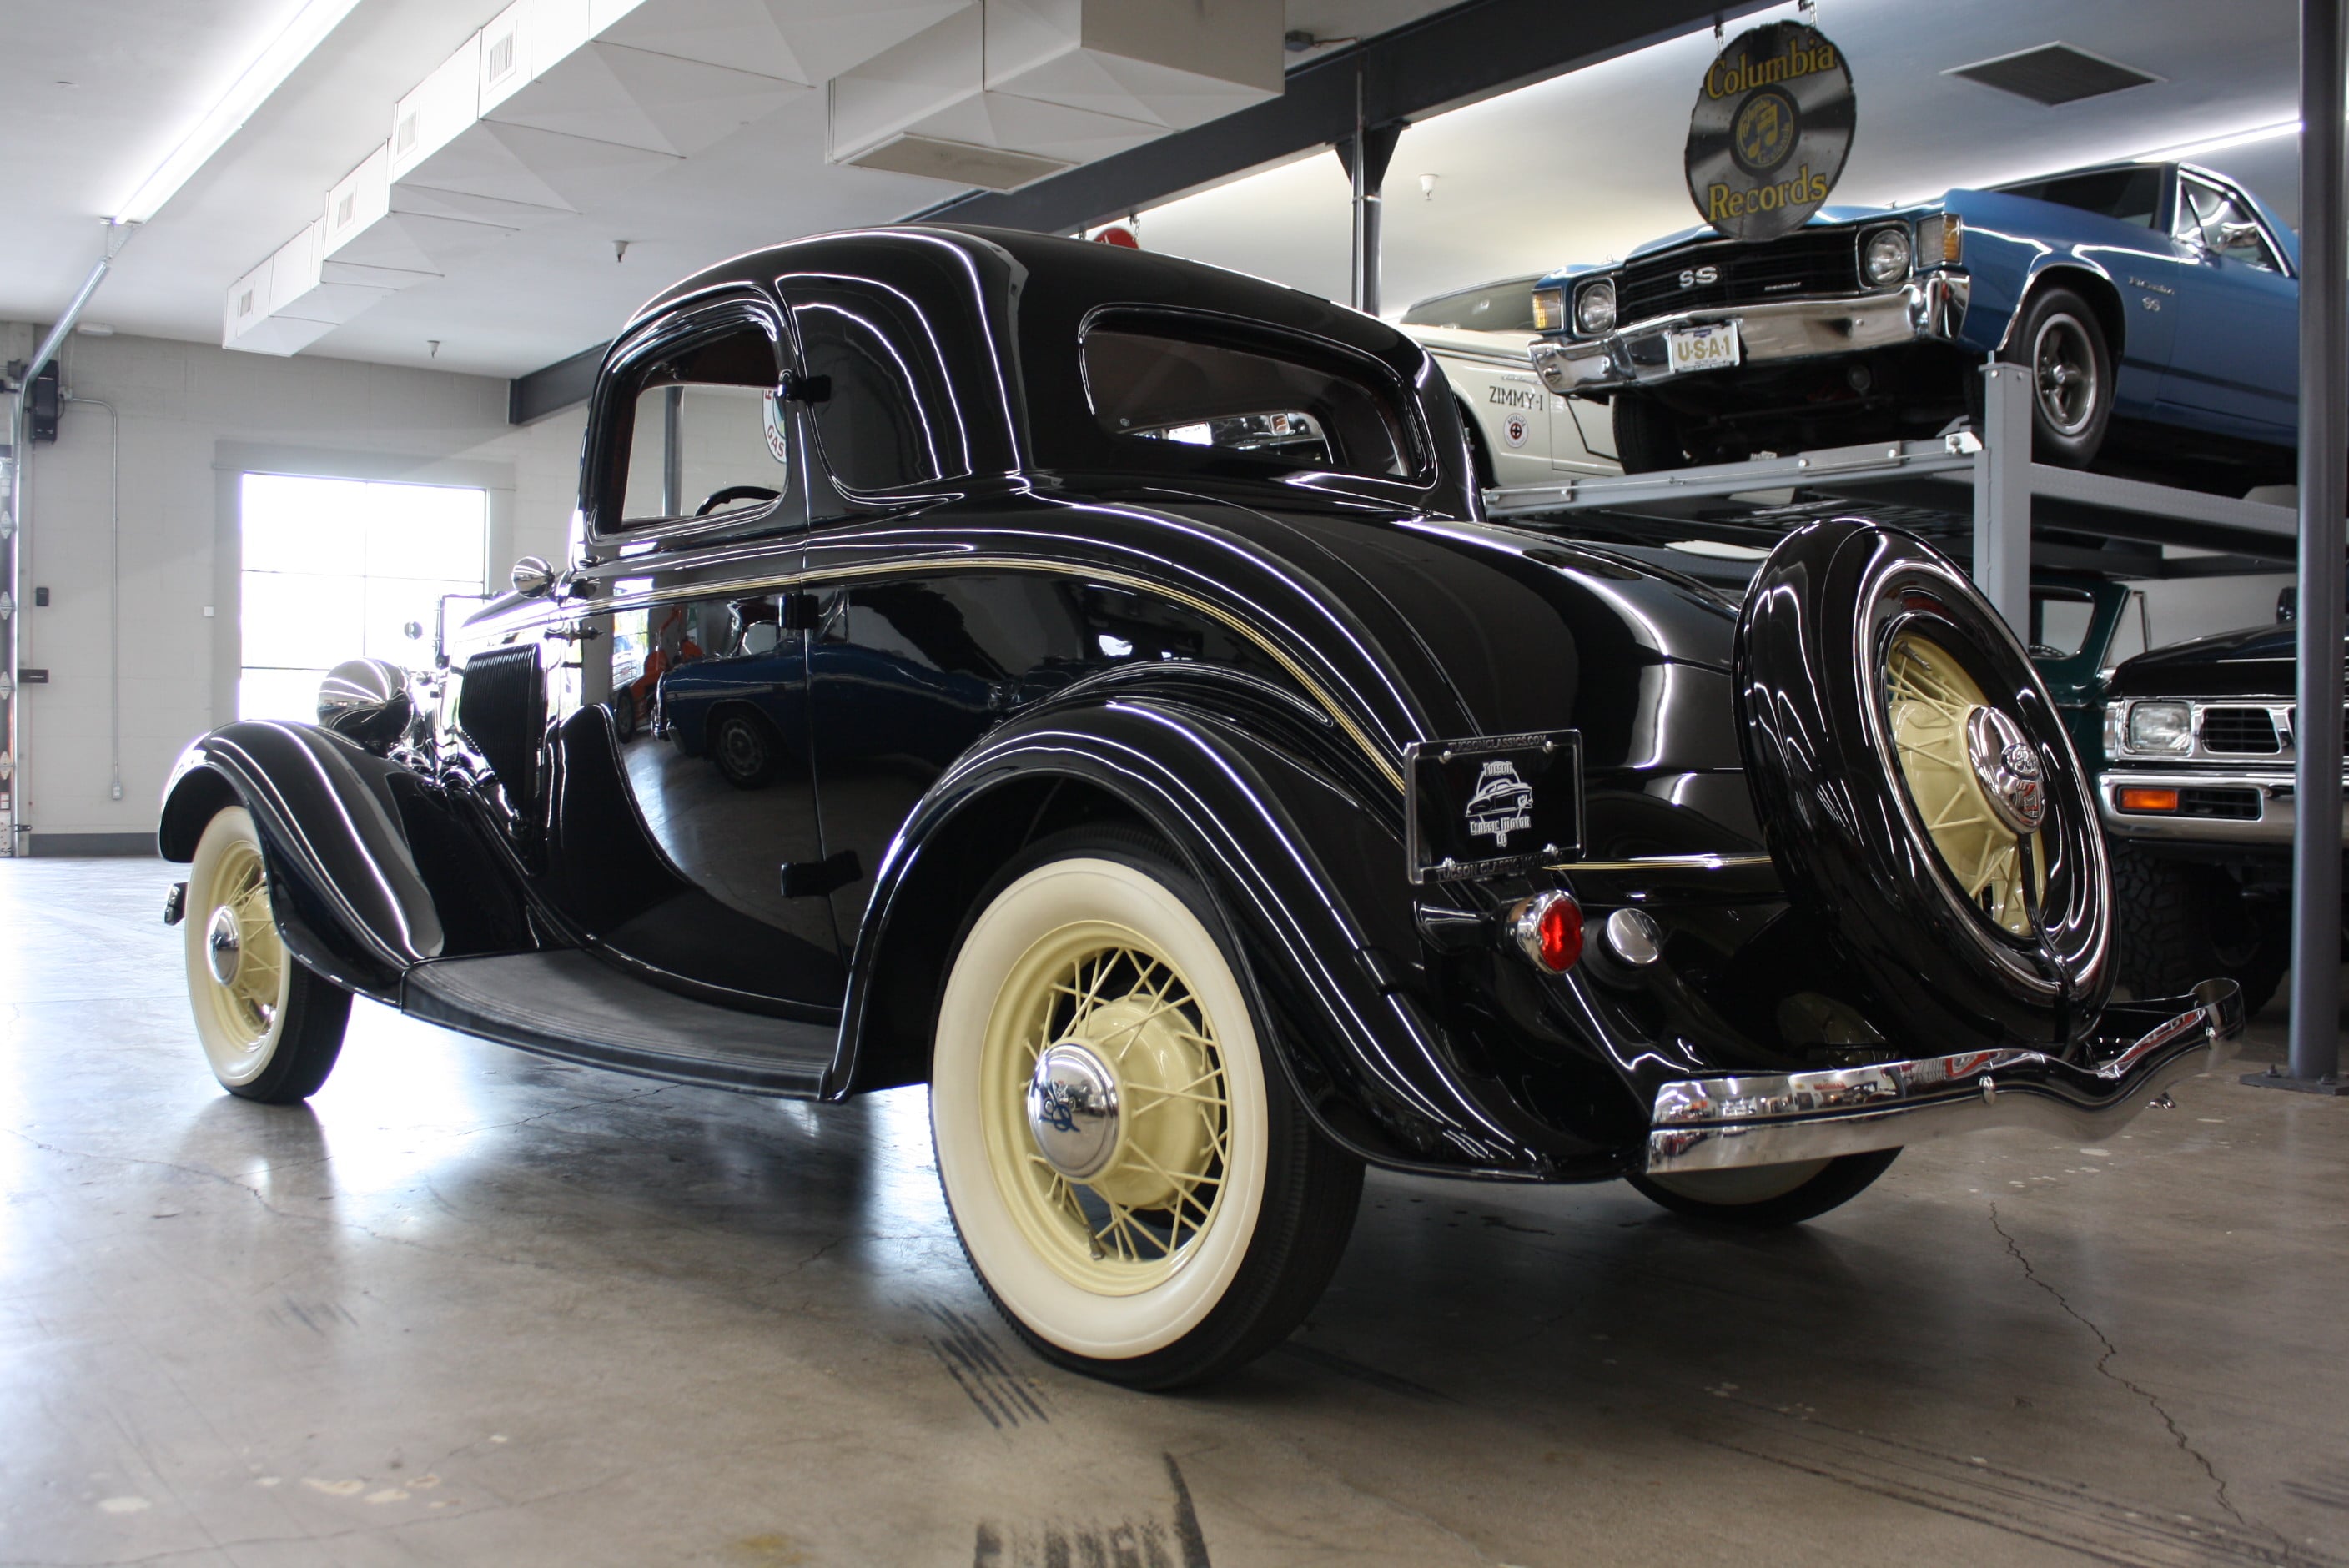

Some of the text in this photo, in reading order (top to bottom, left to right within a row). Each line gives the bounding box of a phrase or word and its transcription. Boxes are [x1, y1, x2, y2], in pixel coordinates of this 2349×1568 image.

[1706, 38, 1838, 99] Columbia
[1708, 164, 1828, 223] Records
[1679, 265, 1718, 289] SS
